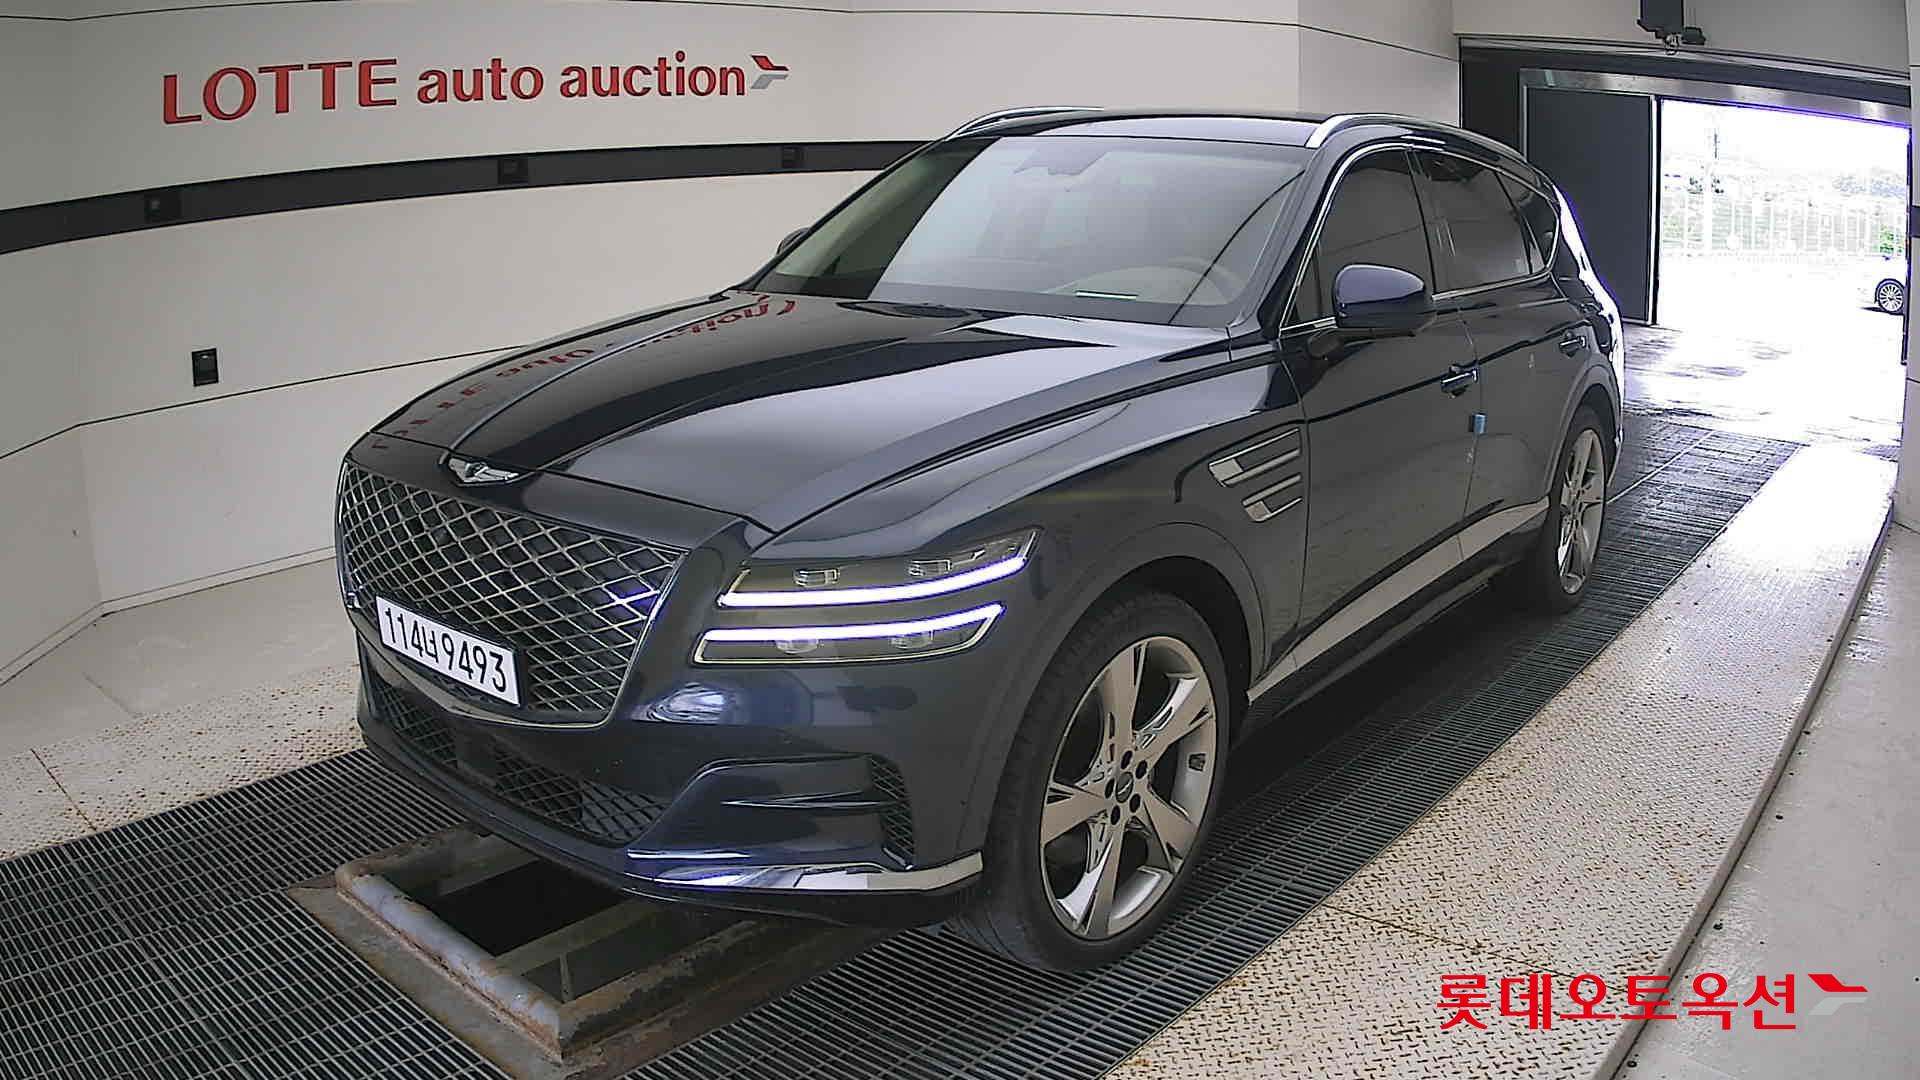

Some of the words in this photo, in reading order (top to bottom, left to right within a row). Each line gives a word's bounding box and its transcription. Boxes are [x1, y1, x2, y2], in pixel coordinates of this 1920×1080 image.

[163, 58, 398, 124] LOTTE
[417, 57, 545, 103] auto
[559, 50, 746, 98] auction
[384, 607, 507, 693] 114너9493
